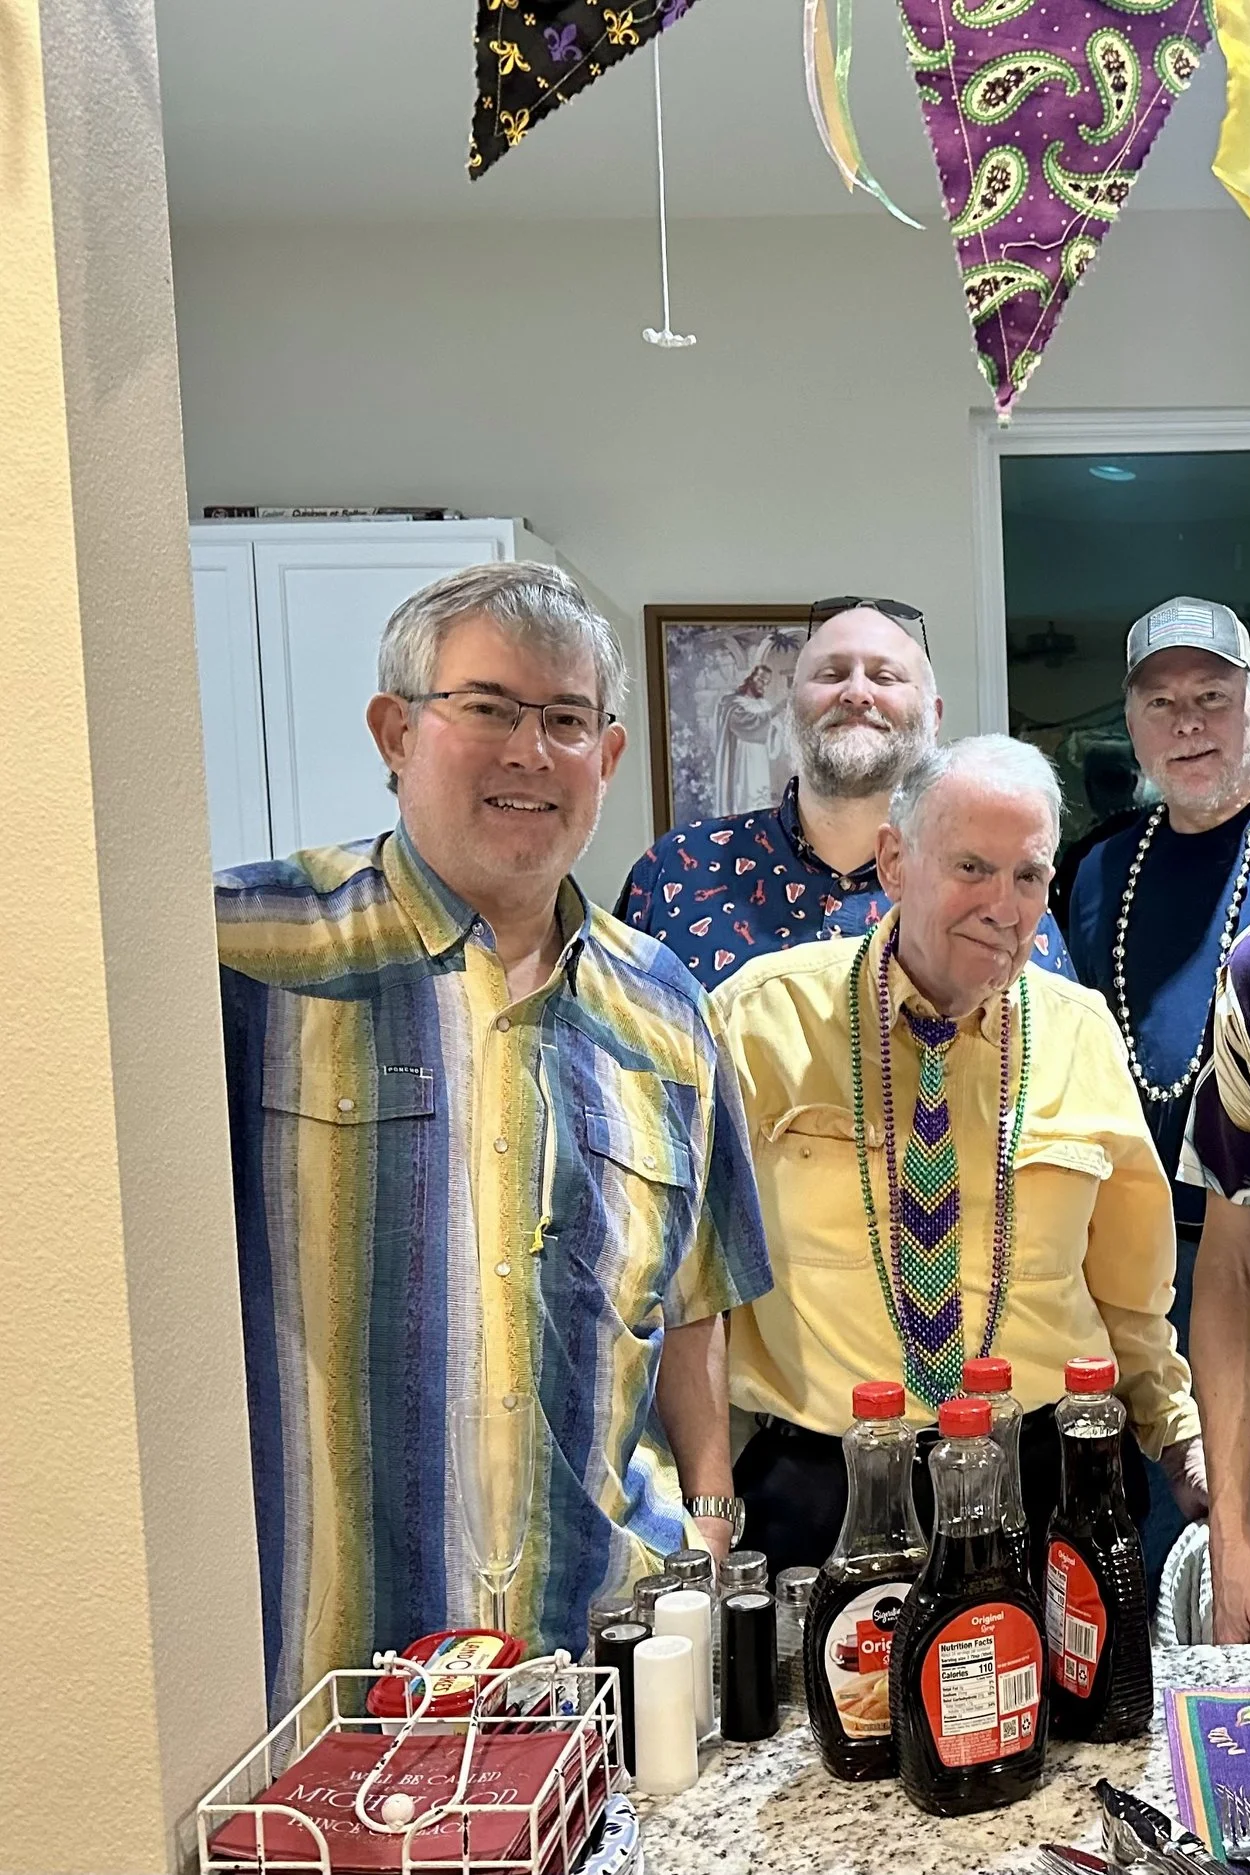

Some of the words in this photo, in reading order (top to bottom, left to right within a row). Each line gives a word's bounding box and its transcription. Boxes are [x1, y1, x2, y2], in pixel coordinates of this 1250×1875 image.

[387, 1066, 420, 1074] PONCHO
[971, 1610, 1005, 1626] Original
[941, 1641, 973, 1652] Nutrition
[974, 1637, 993, 1648] Facts
[941, 1670, 969, 1680] Calories
[979, 1662, 993, 1674] 110
[433, 1674, 458, 1692] AKES
[349, 1770, 394, 1785] WLL
[398, 1774, 425, 1786] BE
[427, 1771, 503, 1786] CALED
[286, 1784, 428, 1812] MIGHY
